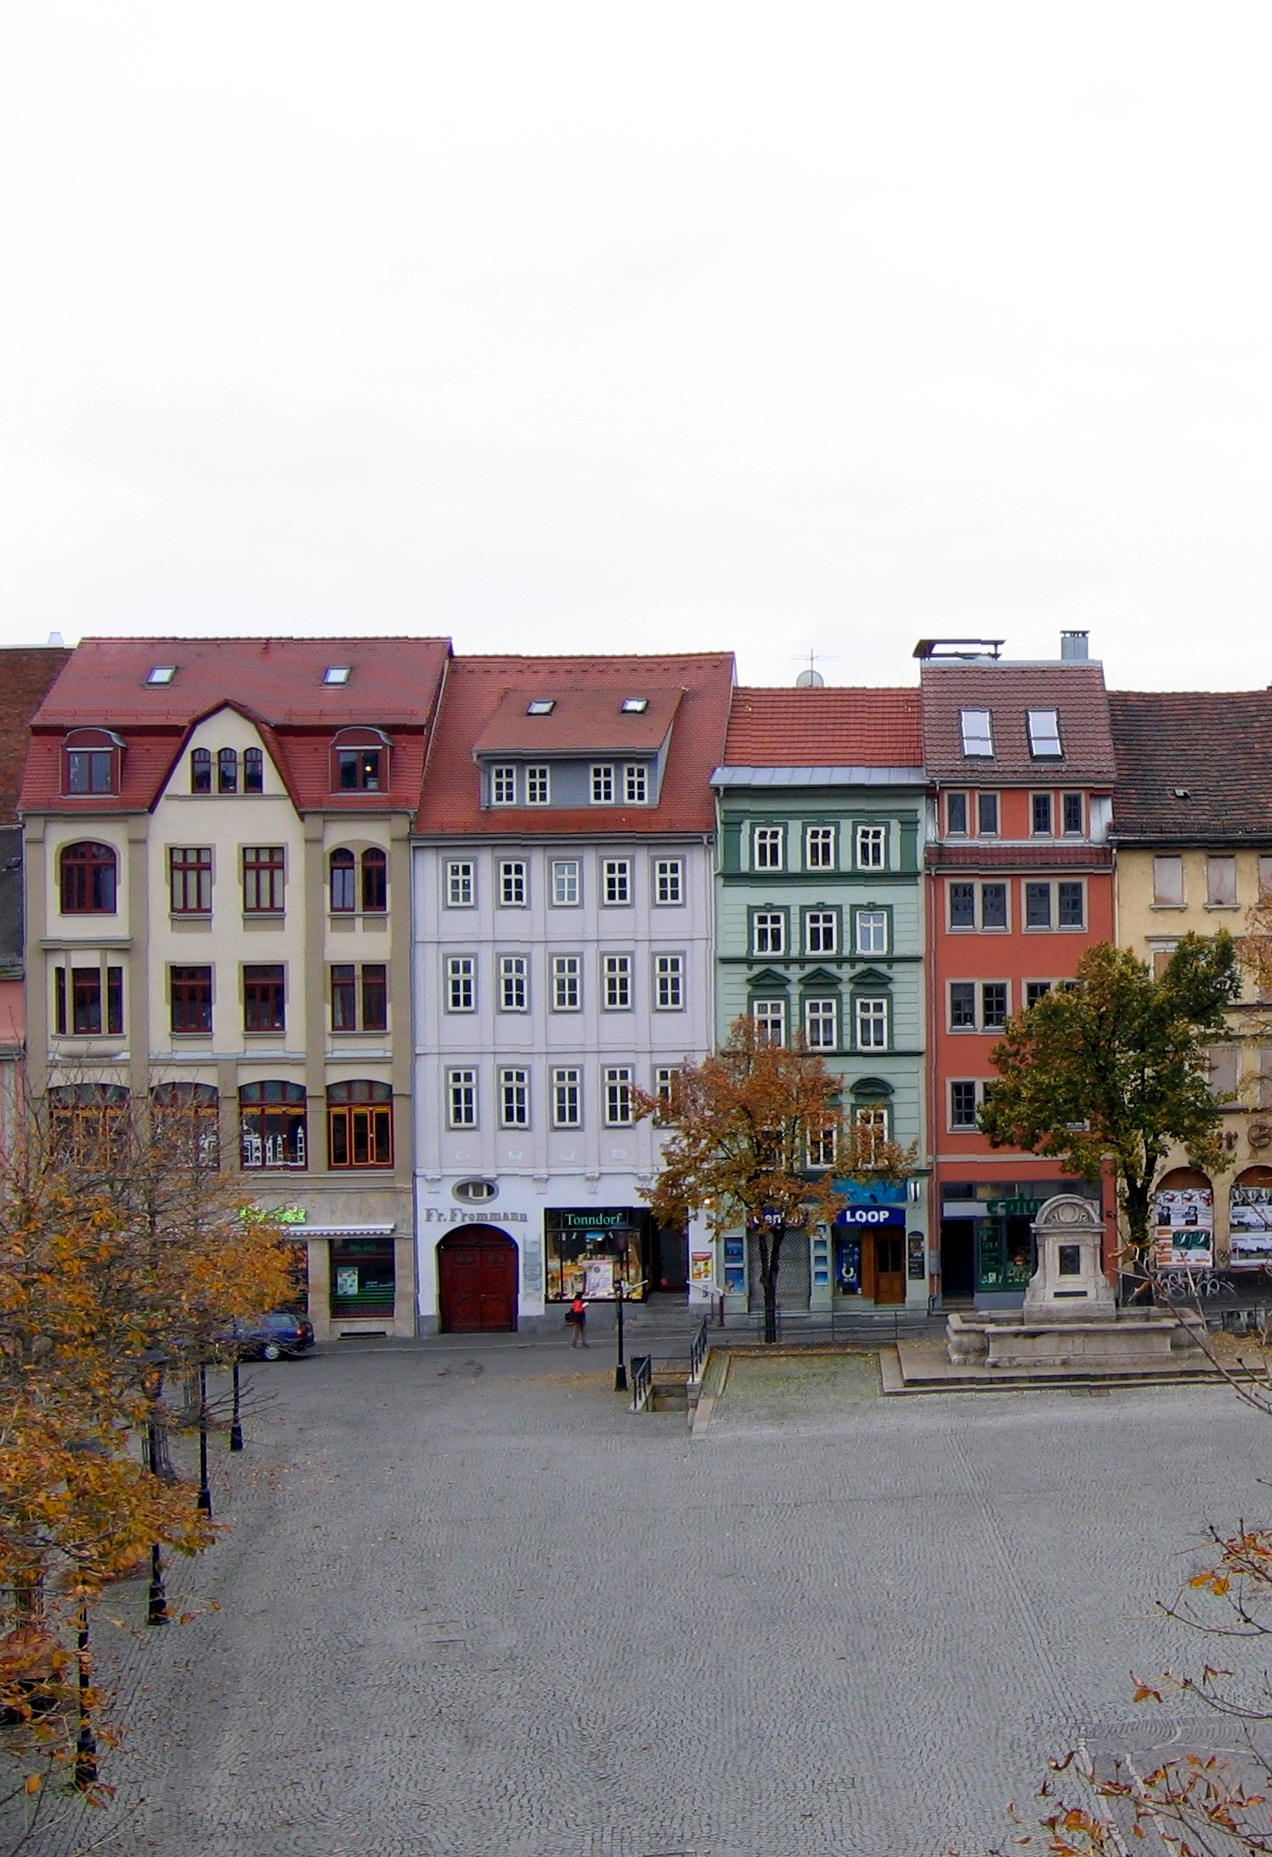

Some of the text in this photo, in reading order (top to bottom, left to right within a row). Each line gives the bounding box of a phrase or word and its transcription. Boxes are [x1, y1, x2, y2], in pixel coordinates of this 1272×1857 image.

[424, 1207, 529, 1223] Fr. Frommann
[565, 1212, 623, 1226] Tonndorf
[845, 1210, 891, 1224] LOOP
